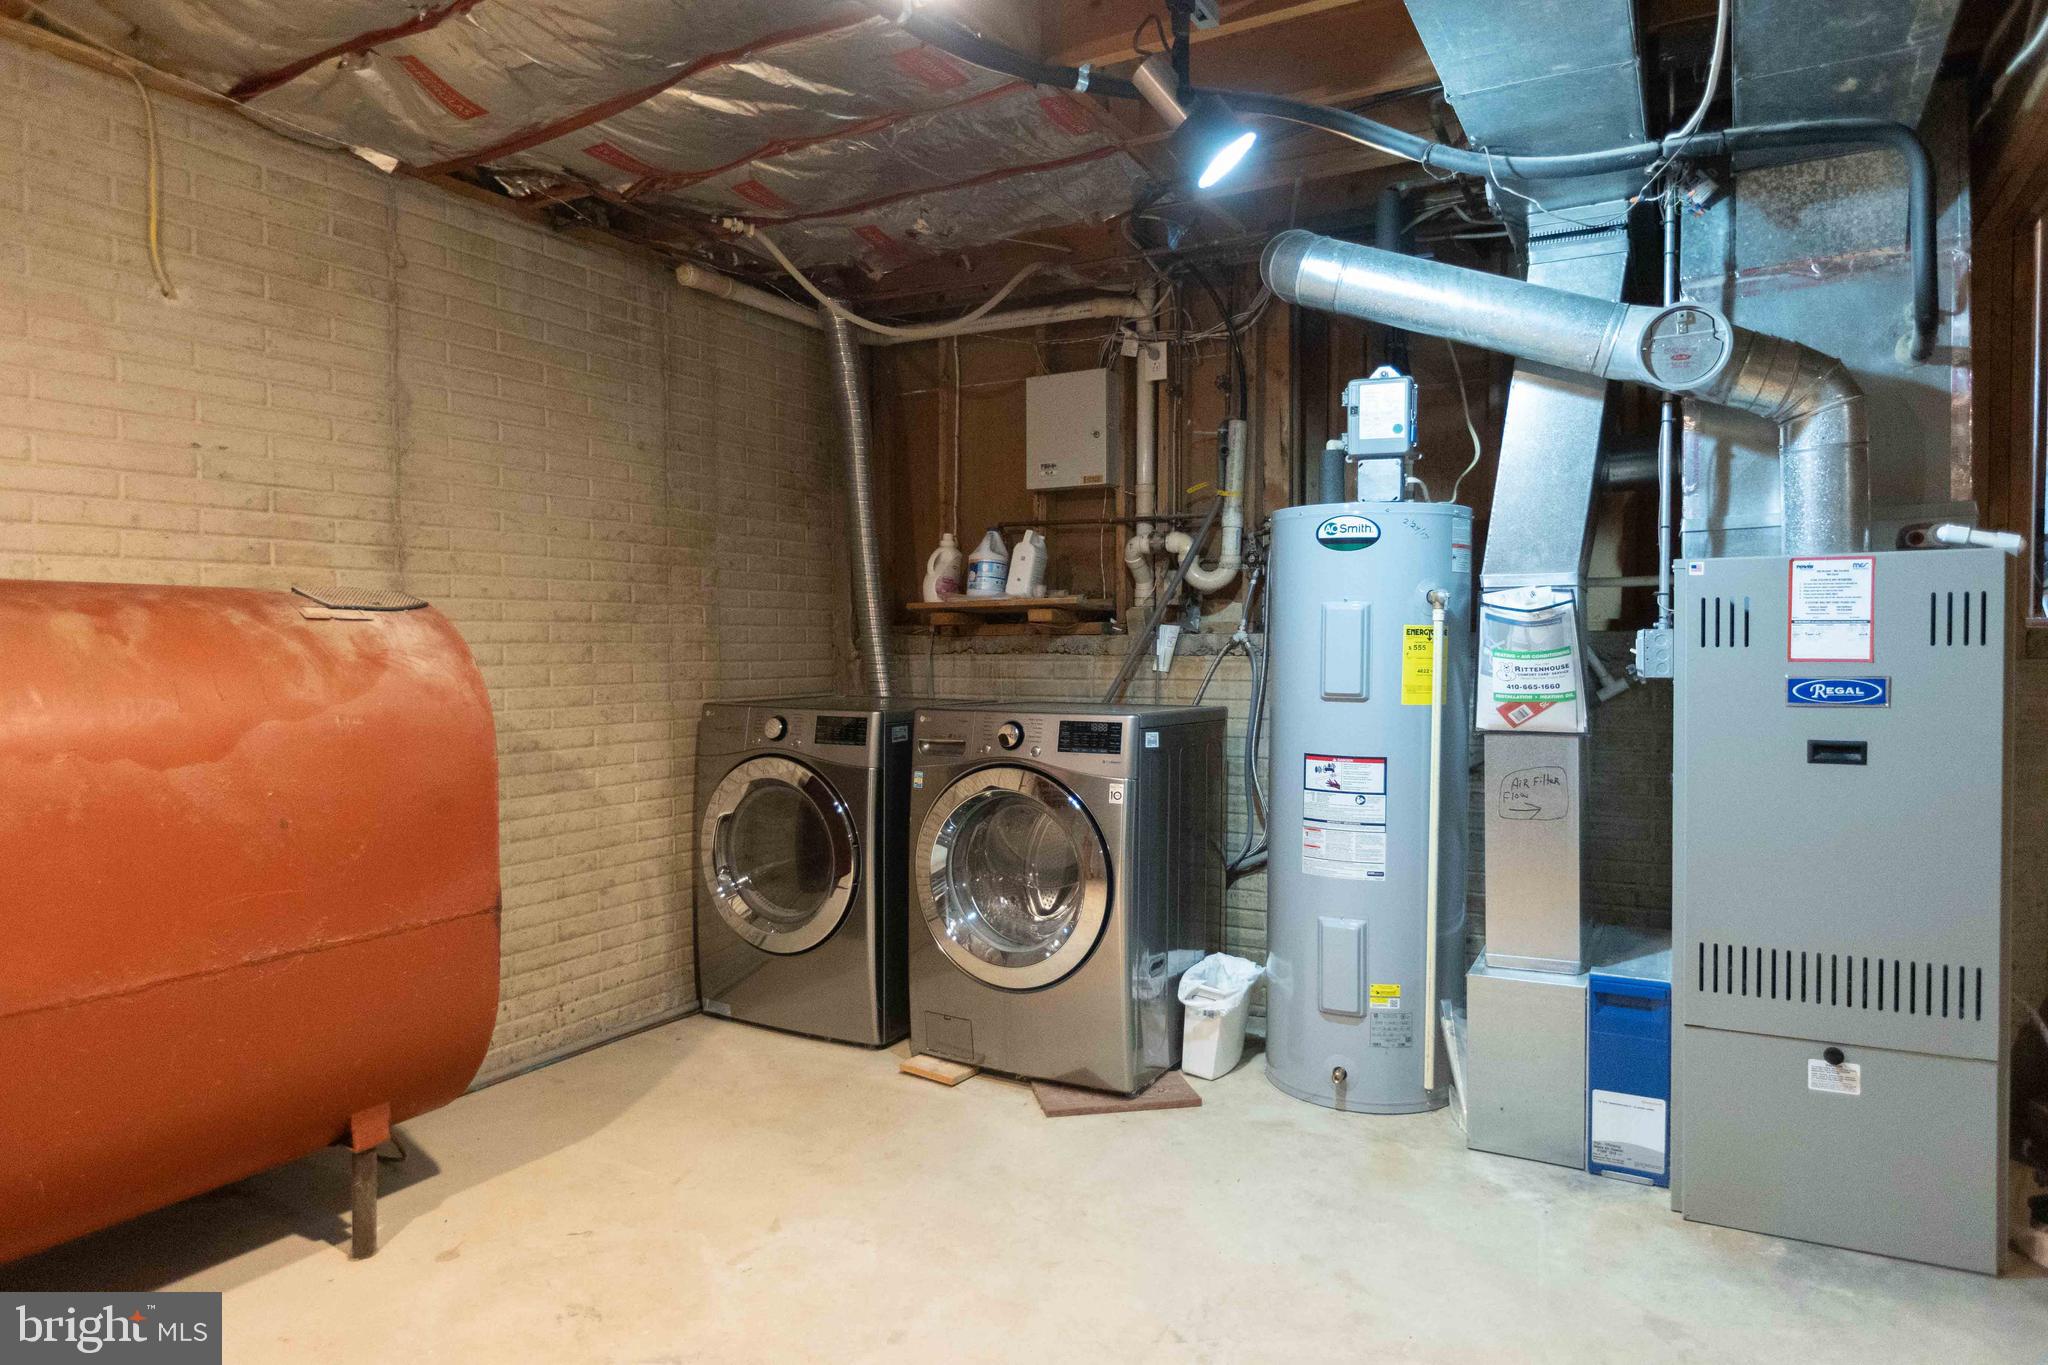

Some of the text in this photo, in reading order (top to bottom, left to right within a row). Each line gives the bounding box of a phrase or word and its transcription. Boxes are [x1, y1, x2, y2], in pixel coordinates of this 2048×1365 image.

[1339, 524, 1372, 534] Smith
[1514, 663, 1570, 672] RITTENHOUSE
[1810, 684, 1864, 698] REGAL
